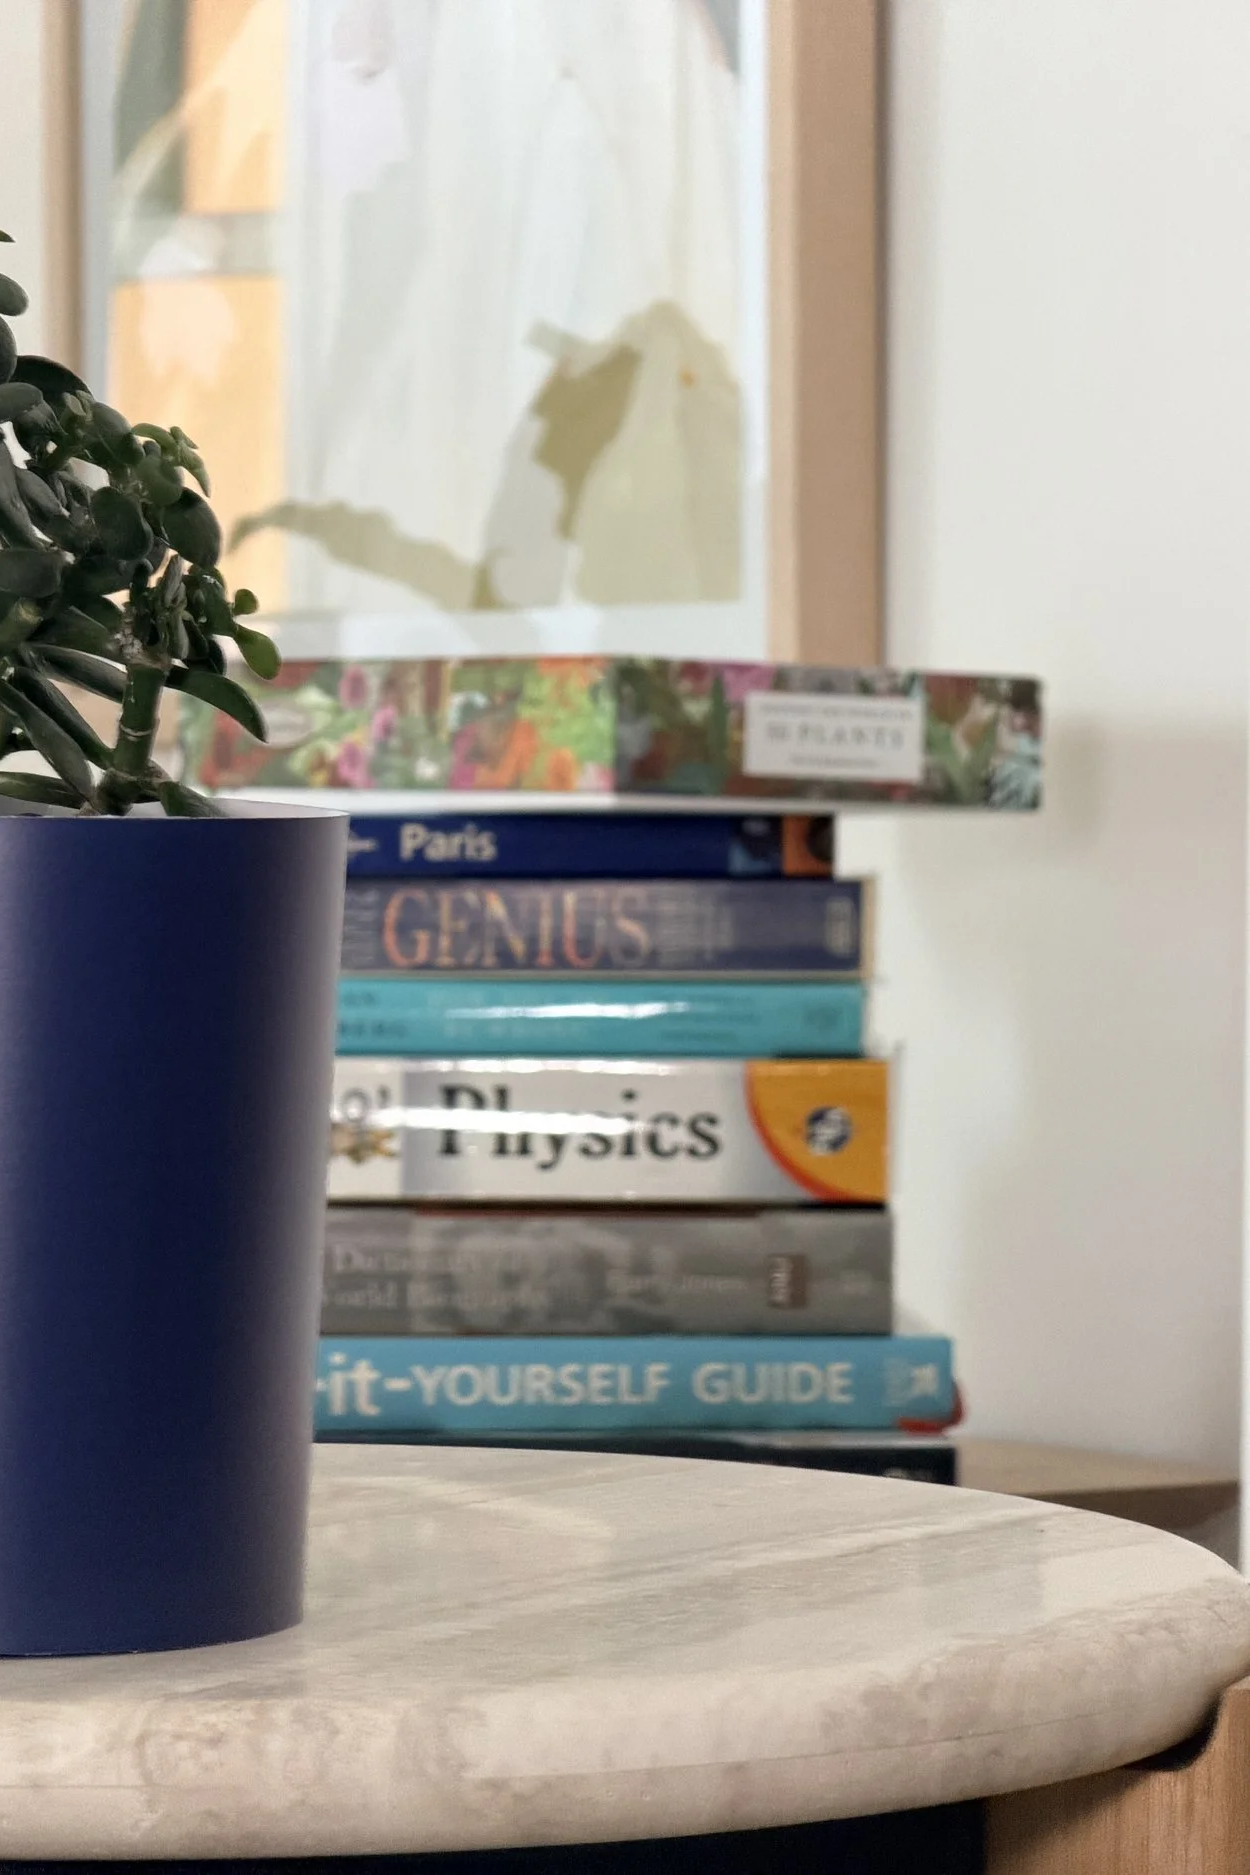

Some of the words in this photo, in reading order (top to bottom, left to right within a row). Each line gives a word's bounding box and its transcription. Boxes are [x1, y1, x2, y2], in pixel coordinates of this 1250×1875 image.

[798, 722, 904, 750] PLANTS
[399, 822, 498, 863] Paris
[382, 887, 652, 970] GENIUS
[438, 1080, 721, 1171] Physics
[322, 1282, 398, 1309] orld
[692, 1362, 855, 1405] GUIDE
